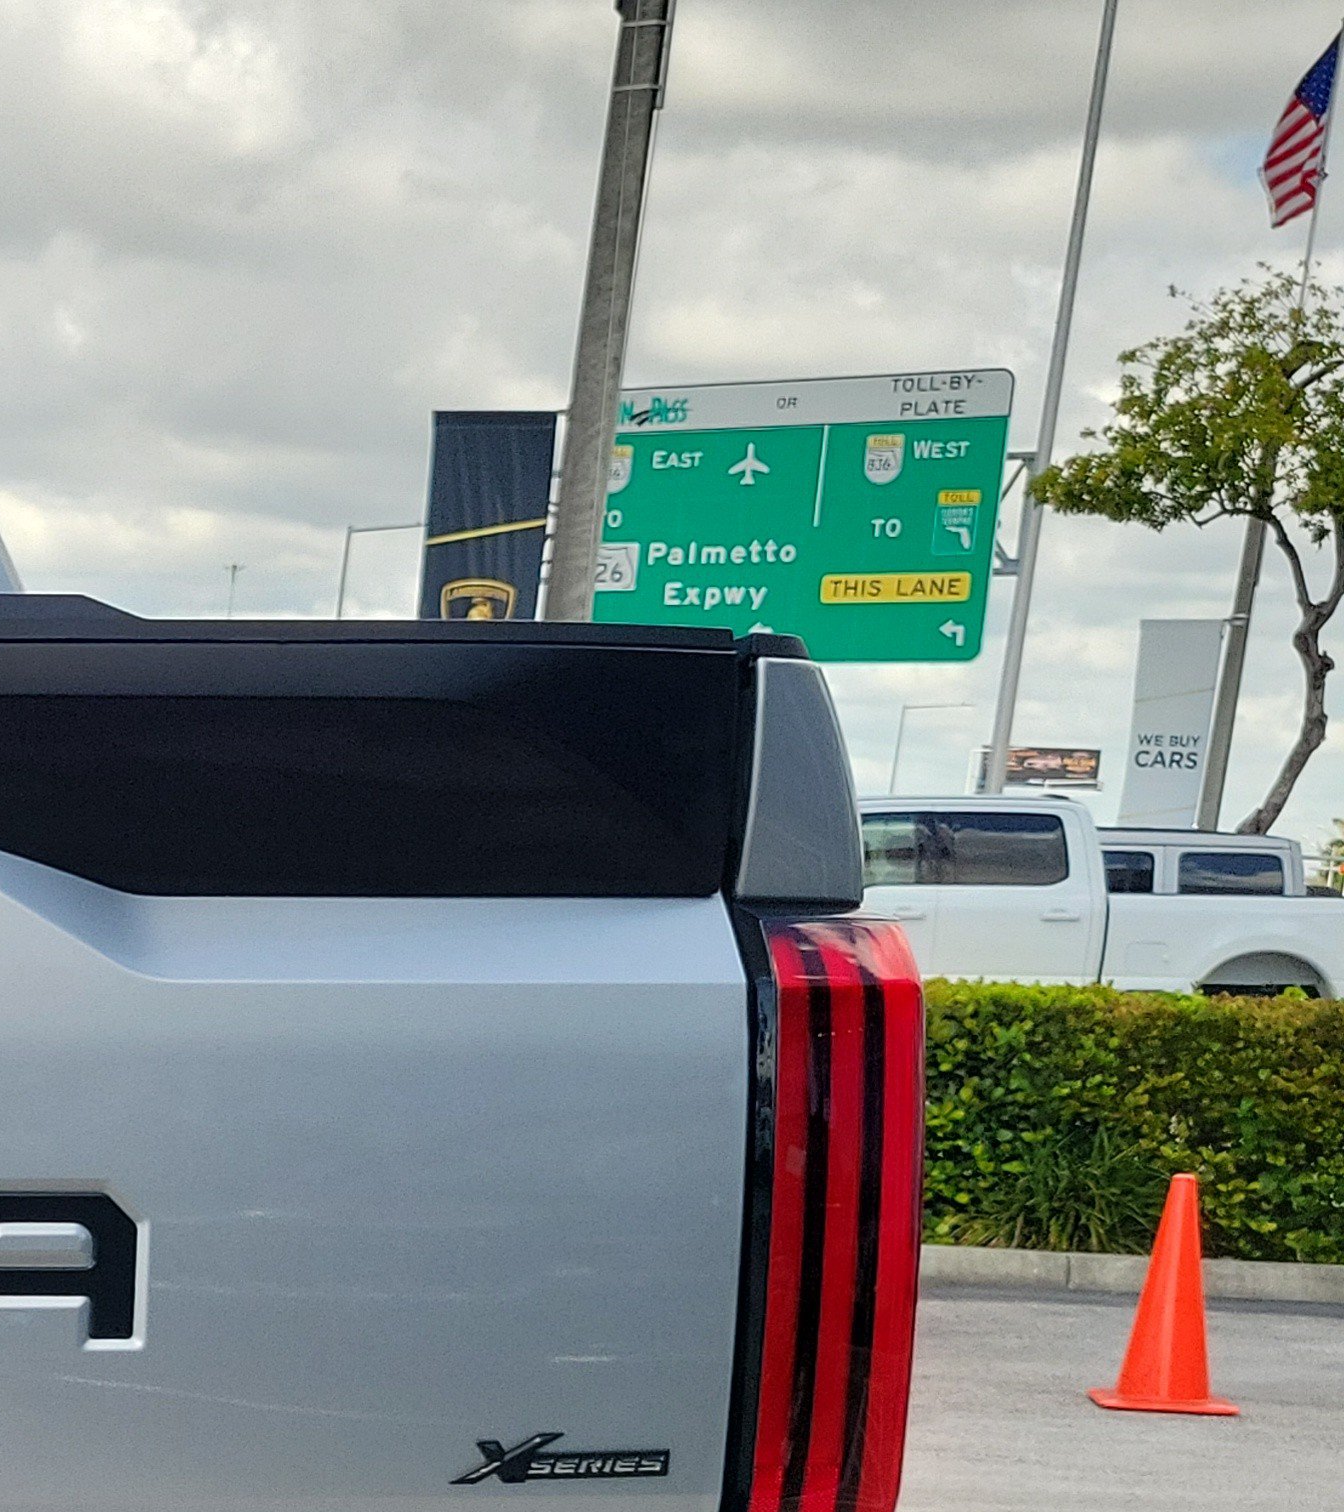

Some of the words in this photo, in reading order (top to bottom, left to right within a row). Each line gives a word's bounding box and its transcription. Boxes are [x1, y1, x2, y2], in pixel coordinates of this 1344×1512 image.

[776, 396, 798, 410] OR
[900, 400, 966, 417] PLATE
[651, 450, 704, 469] EAST
[913, 440, 970, 460] WEST
[943, 491, 975, 503] TOLL
[870, 518, 902, 538] TO
[647, 539, 797, 566] Palmetto
[595, 563, 624, 584] 26
[663, 581, 768, 611] Expwy
[830, 578, 881, 598] THIS
[896, 577, 962, 597] LANE
[1137, 733, 1164, 747] WE
[1169, 734, 1200, 748] BUY
[1134, 750, 1199, 770] CARS
[448, 1432, 565, 1485] X
[526, 1452, 666, 1477] SERIES
